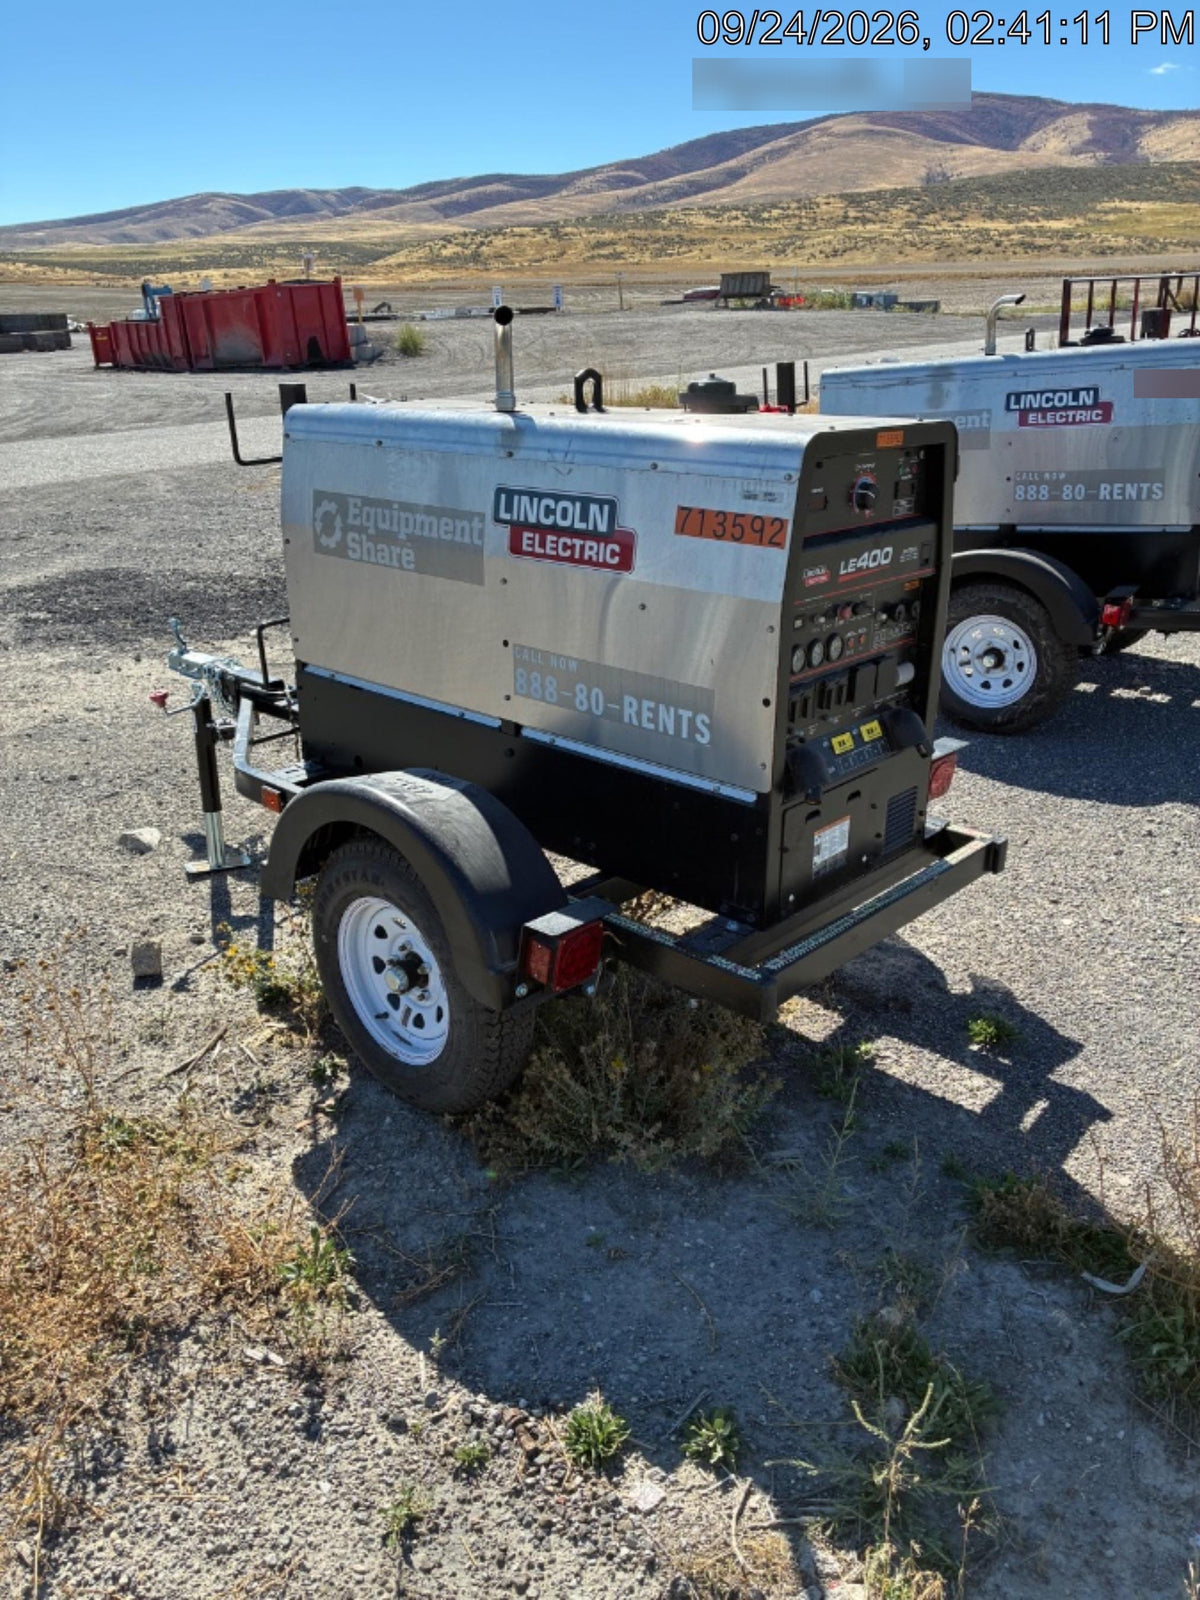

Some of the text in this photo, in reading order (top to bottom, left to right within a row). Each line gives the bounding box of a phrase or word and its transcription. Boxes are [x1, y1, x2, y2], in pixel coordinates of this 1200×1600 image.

[1009, 390, 1095, 410] LINCOLN
[1027, 409, 1103, 424] ELECTRIC
[1015, 482, 1163, 500] 888-80-RENTS
[346, 497, 484, 546] Equipment
[498, 493, 610, 533] LINCOLN
[679, 505, 785, 546] 713592
[346, 531, 416, 570] Share
[521, 531, 620, 565] ELECTRIC
[839, 547, 893, 575] LE400
[514, 647, 579, 673] CALL NOW
[514, 667, 712, 745] 888-80-RENTS
